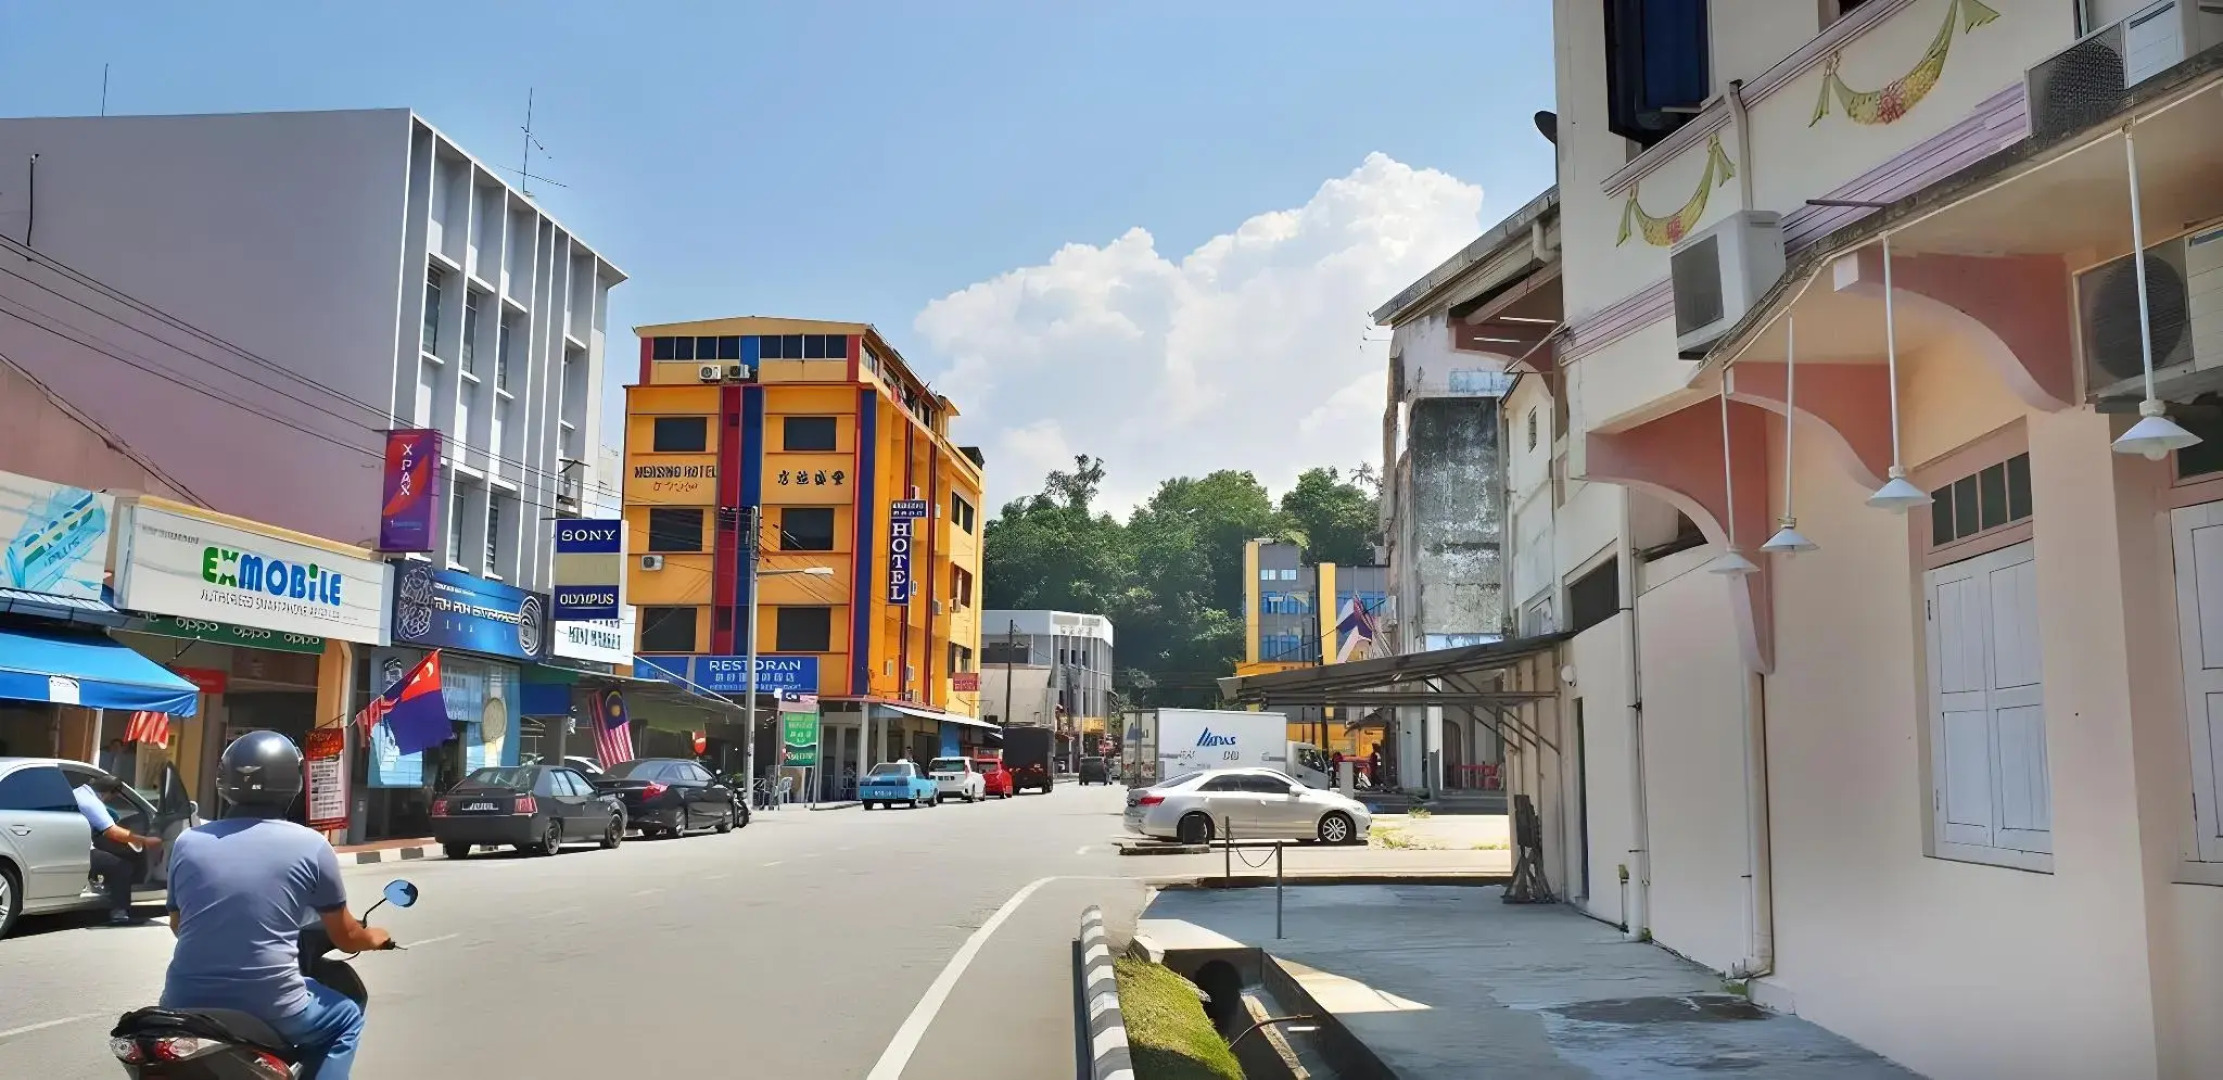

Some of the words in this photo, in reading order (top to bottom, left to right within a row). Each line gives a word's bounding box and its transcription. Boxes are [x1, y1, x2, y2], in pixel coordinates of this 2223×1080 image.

[400, 443, 413, 496] XPAX
[561, 529, 616, 541] SONY
[890, 522, 913, 600] HOTEL
[560, 593, 614, 605] OLYMPUS
